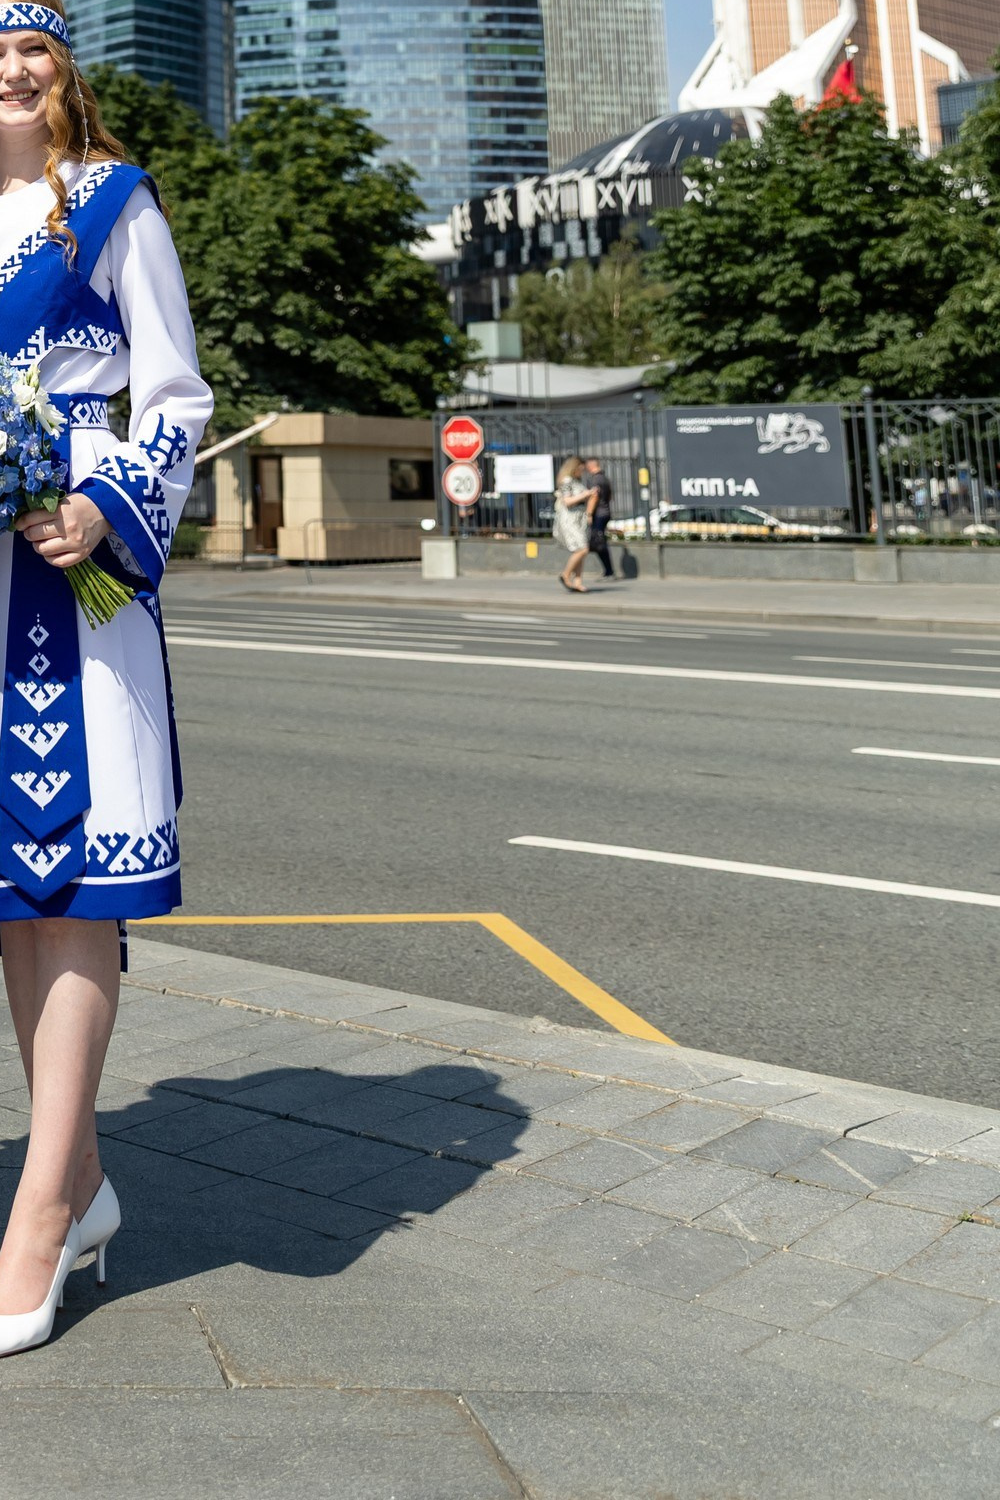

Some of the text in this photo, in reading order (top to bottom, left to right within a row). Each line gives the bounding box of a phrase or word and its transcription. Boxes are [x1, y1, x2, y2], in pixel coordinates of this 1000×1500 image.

[446, 432, 478, 447] STOP
[454, 476, 474, 494] 20
[681, 478, 725, 497] КПП
